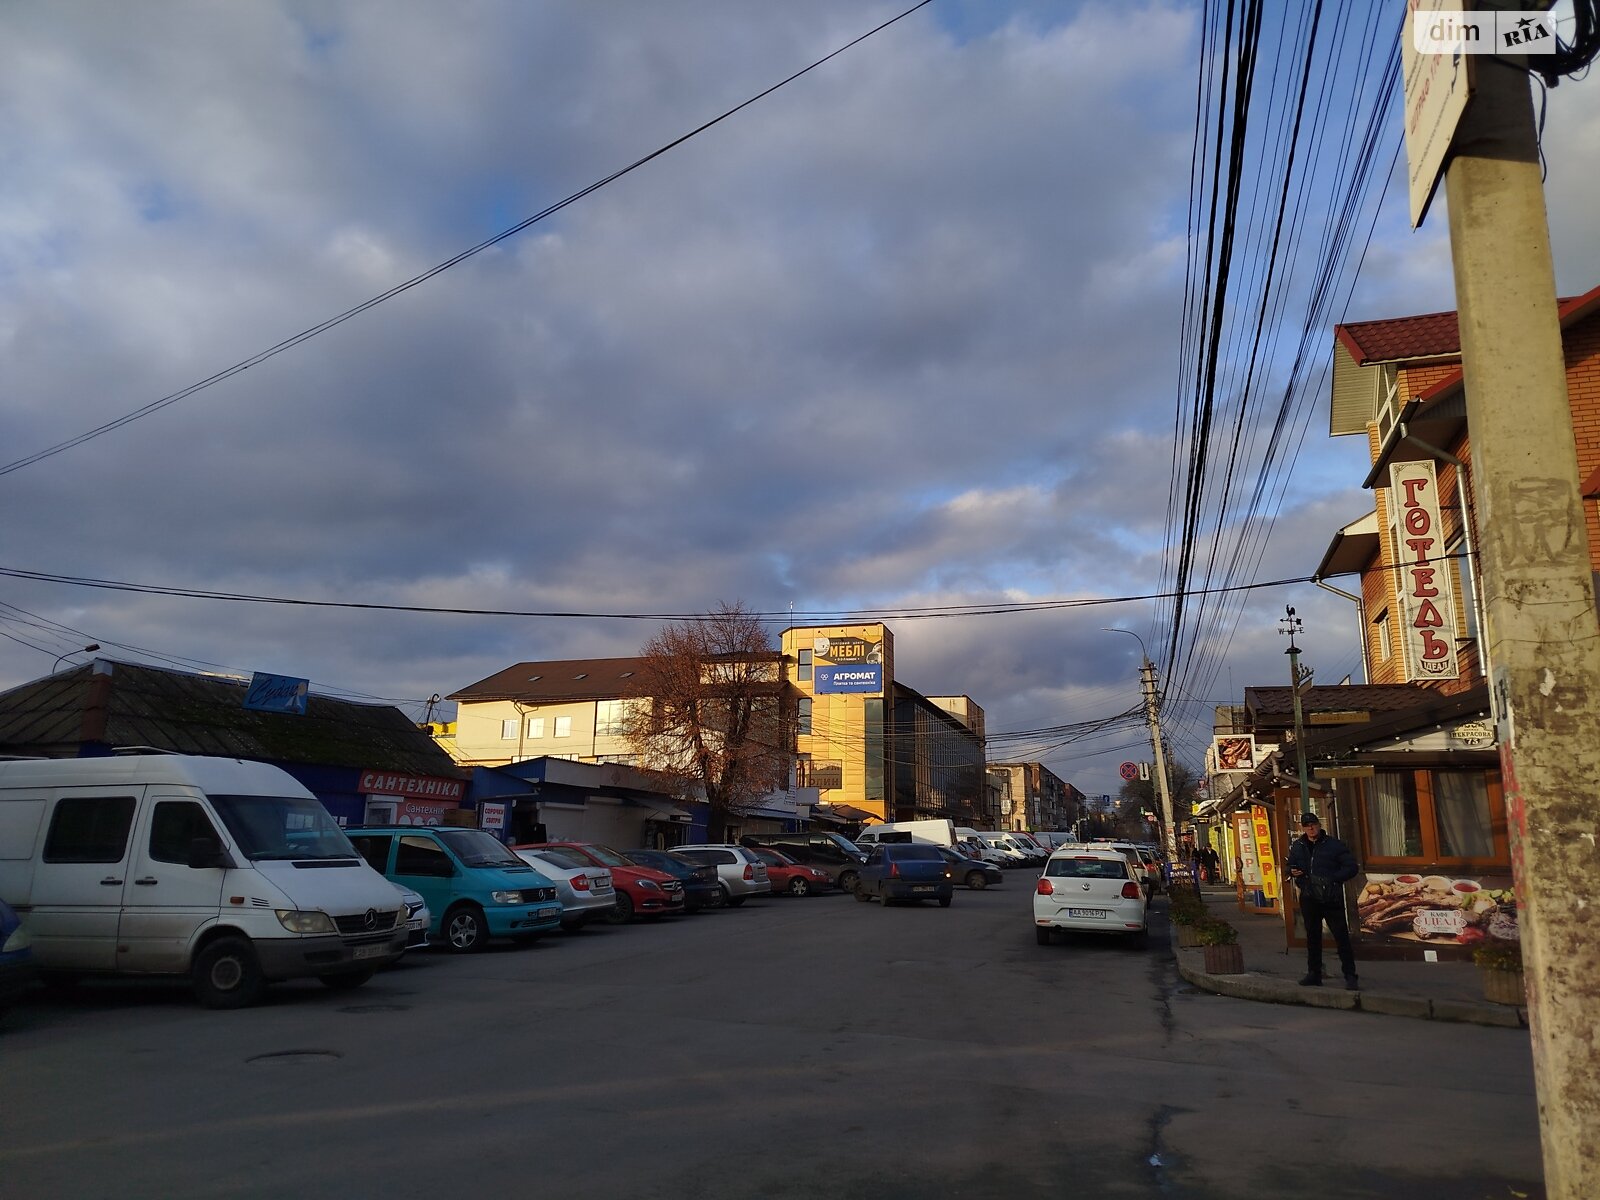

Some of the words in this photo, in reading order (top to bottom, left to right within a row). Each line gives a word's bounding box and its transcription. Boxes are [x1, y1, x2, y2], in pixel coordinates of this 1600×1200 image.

[1402, 478, 1449, 660] ГОТЕЛЬ
[830, 644, 864, 657] МЕБЛІ
[1424, 662, 1448, 671] ІДЕАЛ
[833, 672, 876, 681] АГРОМАТ
[363, 774, 461, 797] САНТЕХНІКА
[405, 802, 447, 815] Сантехнік
[1254, 806, 1273, 895] ДВЕРІ
